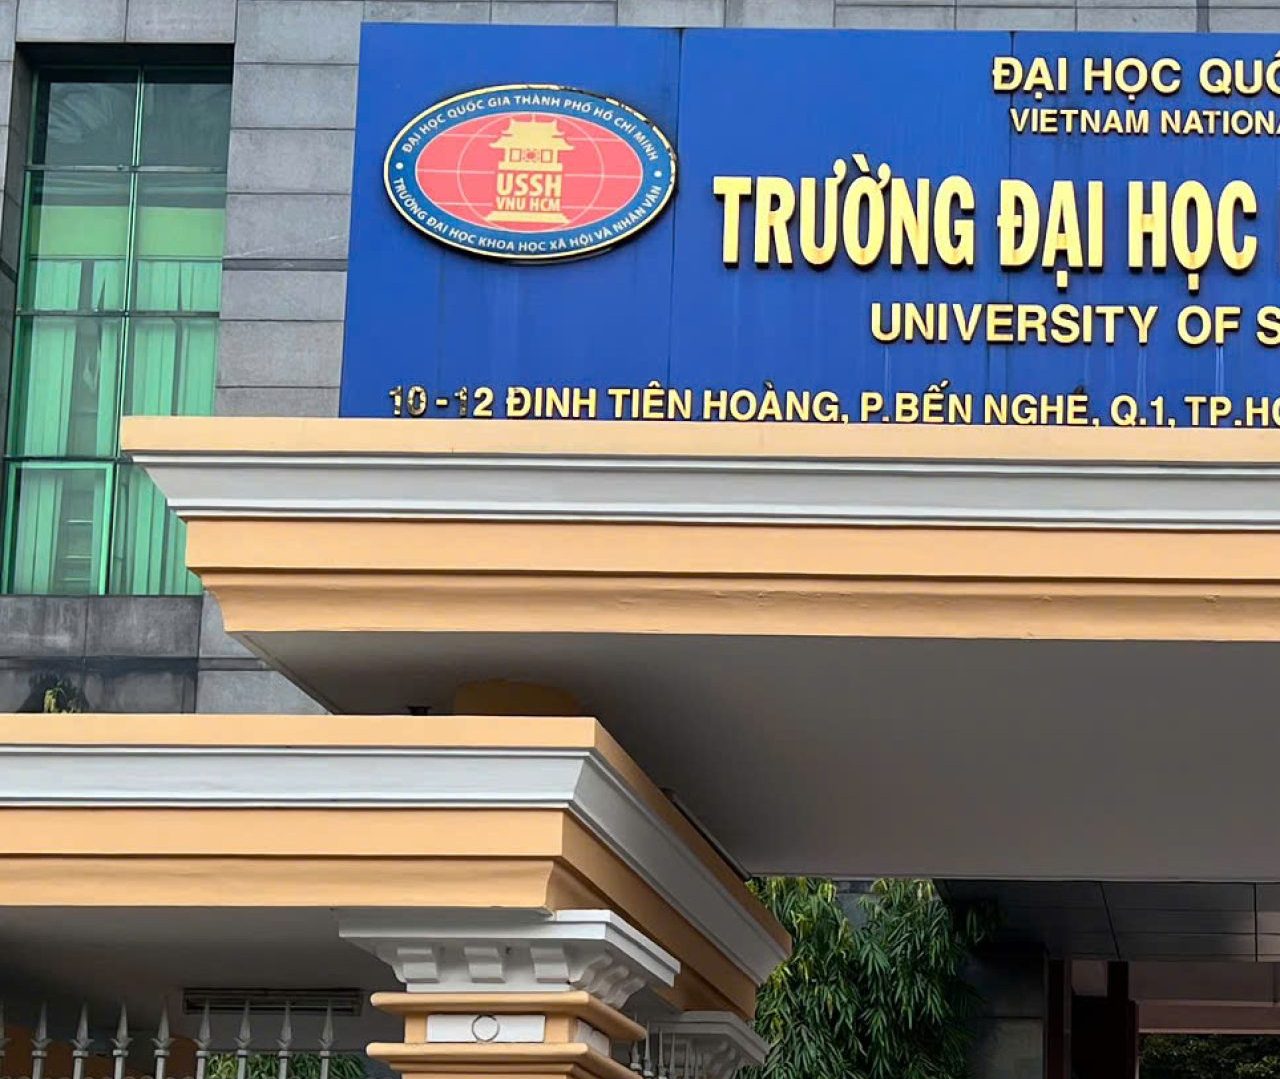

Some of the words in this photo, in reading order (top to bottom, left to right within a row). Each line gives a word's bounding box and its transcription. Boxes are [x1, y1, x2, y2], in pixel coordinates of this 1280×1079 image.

[992, 57, 1067, 101] ĐẠI
[1084, 57, 1182, 102] HỌC
[402, 132, 421, 153] ĐẠI
[420, 113, 446, 134] HỌC
[447, 99, 485, 119] QUỐC
[488, 96, 510, 107] GIA
[513, 94, 560, 108] THÀNH
[563, 98, 593, 113] PHỐ
[614, 117, 637, 134] CHÍ
[633, 131, 659, 160] MINH
[1010, 108, 1150, 135] VIETNAM
[496, 173, 562, 198] USSH
[496, 197, 525, 211] VNU
[529, 198, 561, 212] HCM
[393, 177, 428, 220] TRƯỜNG
[426, 215, 447, 233] ĐẠI
[448, 228, 477, 245] HỌC
[478, 237, 515, 251] KHOA
[518, 241, 546, 254] HỌC
[549, 237, 567, 250] XÃ
[569, 233, 594, 248] HỘI
[594, 226, 613, 240] VÀ
[612, 206, 647, 232] NHÂN
[642, 185, 662, 209] VĂN
[713, 153, 976, 267] TRƯỜNG
[997, 179, 1104, 288] ĐẠI
[1128, 180, 1258, 291] HỌC
[871, 303, 1158, 345] UNIVERSITY
[1178, 305, 1241, 346] OF
[506, 387, 597, 418] ĐINH
[607, 380, 692, 420] TIÊN
[703, 381, 849, 425] HOÀNG,
[1110, 395, 1176, 429] Q.1,
